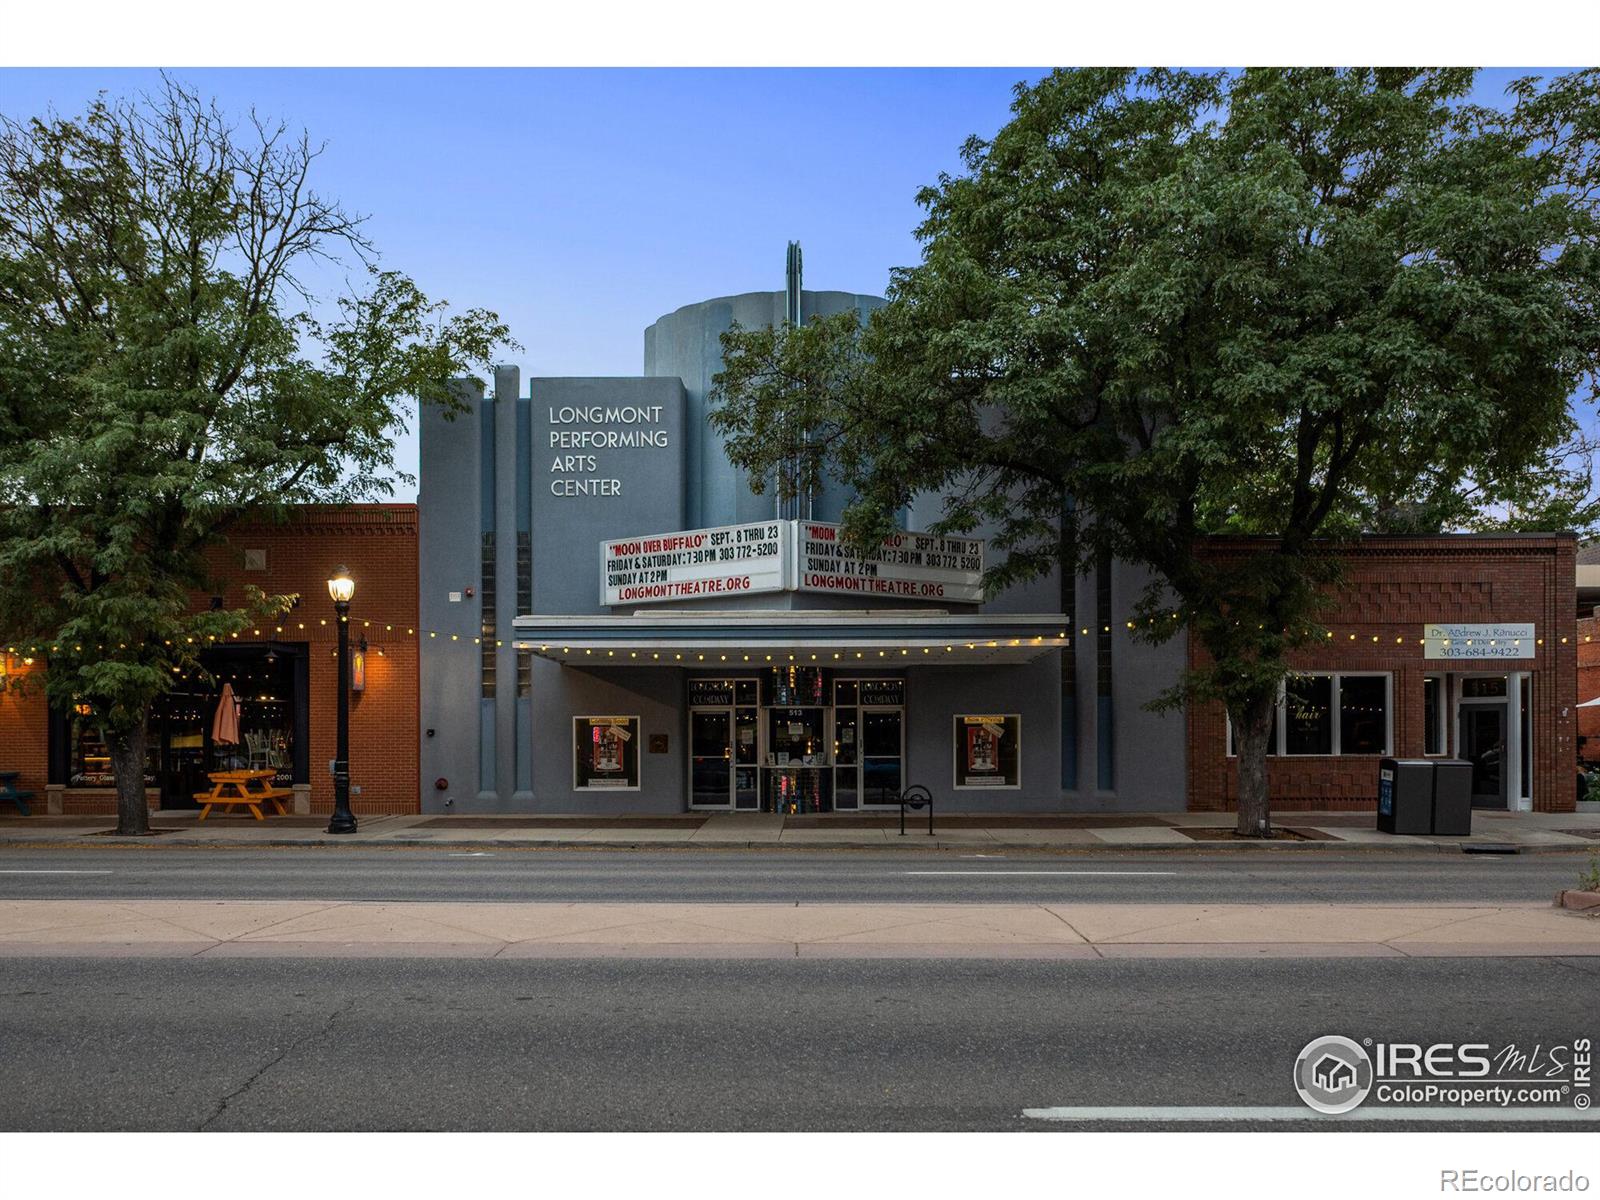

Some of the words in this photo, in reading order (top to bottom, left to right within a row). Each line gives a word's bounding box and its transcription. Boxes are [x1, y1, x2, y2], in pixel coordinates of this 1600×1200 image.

[549, 406, 663, 424] LONGMONT
[550, 430, 668, 448] PERFORMING
[551, 455, 597, 473] ARTS
[550, 479, 621, 497] CENTER
[643, 539, 662, 554] OVER
[710, 531, 734, 546] SEPT.
[736, 530, 742, 542] 8
[744, 527, 765, 541] THRU
[768, 525, 778, 539] 23
[915, 537, 938, 552] SEPT.
[940, 540, 945, 552] 8
[947, 540, 966, 554] THRU
[969, 543, 979, 556] 23
[607, 556, 634, 572] FRIDAY
[634, 557, 641, 569] &
[805, 542, 836, 557] FRIDAY
[836, 545, 843, 557] &
[960, 556, 981, 571] 5200
[807, 558, 842, 573] SUNDAY
[844, 562, 855, 575] AT
[608, 572, 637, 586] SUNDAY
[638, 571, 649, 584] AT
[1440, 647, 1520, 657] 303-684-9422
